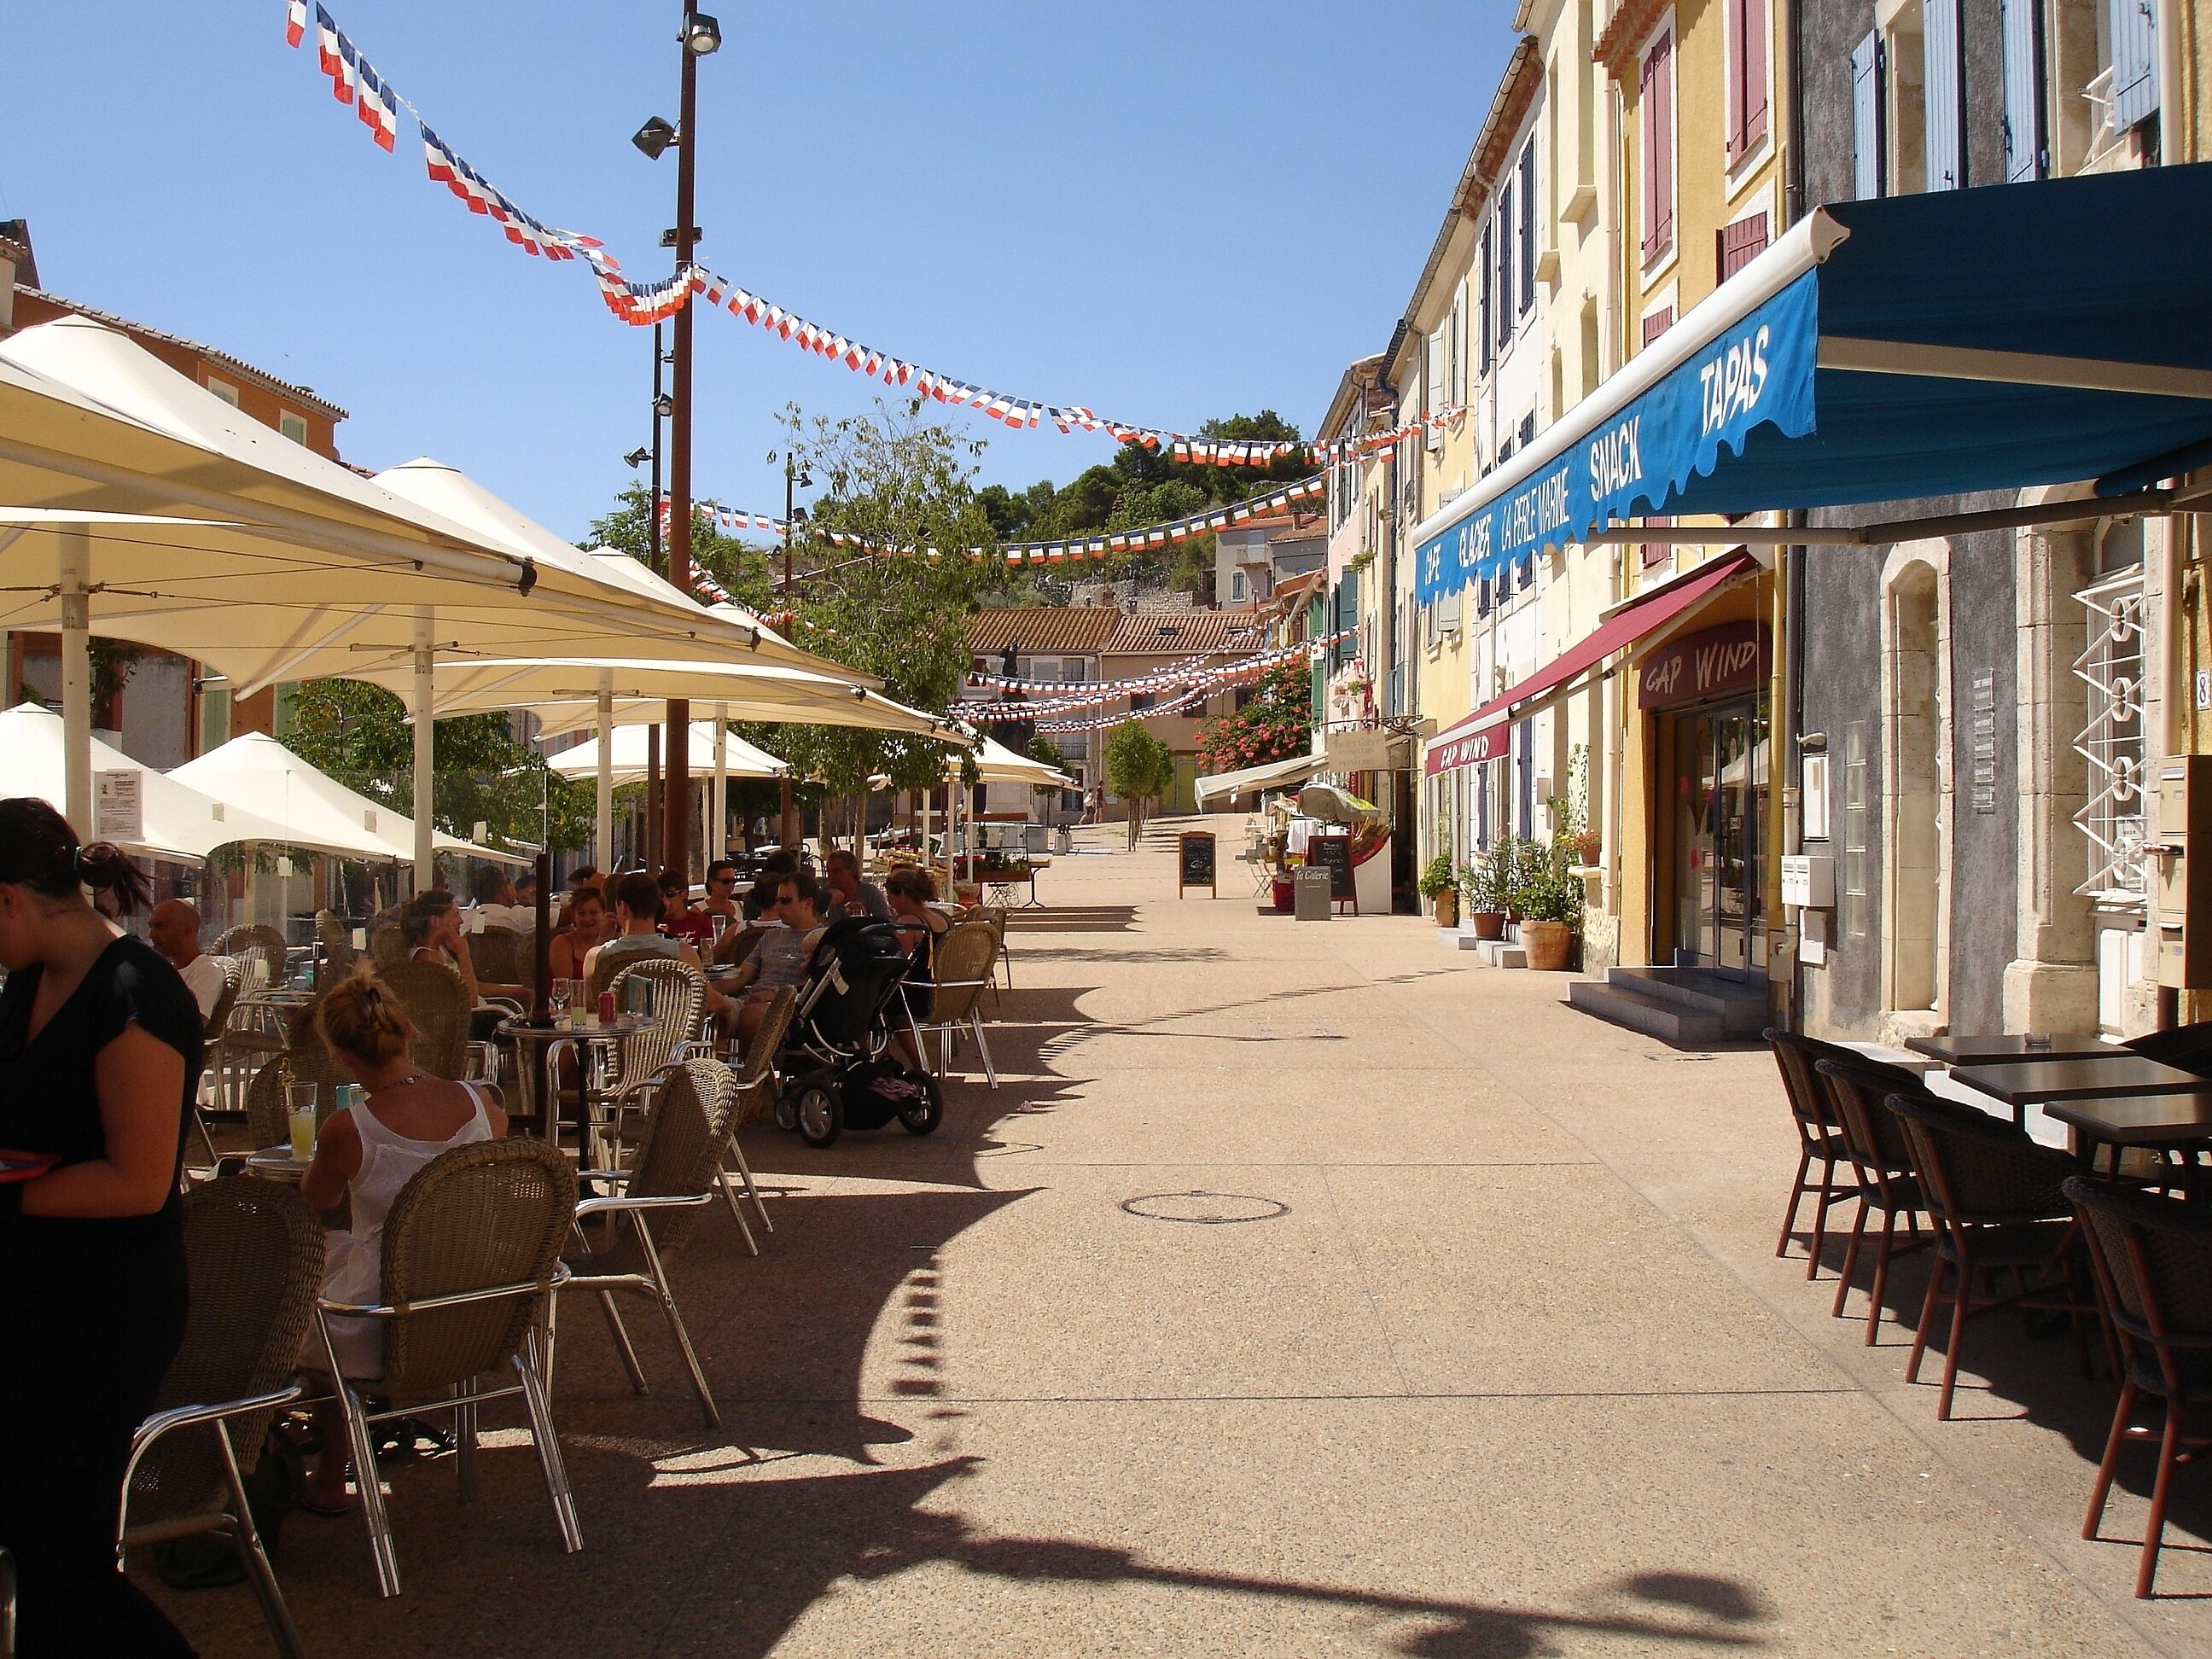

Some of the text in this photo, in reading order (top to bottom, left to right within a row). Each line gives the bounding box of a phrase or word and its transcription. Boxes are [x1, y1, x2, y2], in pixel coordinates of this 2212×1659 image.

[1459, 513, 1492, 568] GLACIER
[1502, 504, 1511, 552] LA
[1514, 487, 1536, 547] PERLE
[1538, 467, 1570, 536] MARINE
[1590, 415, 1642, 502] SNACK
[1700, 324, 1769, 437] TAPAS
[1645, 641, 1756, 694] CAP WIND
[2199, 677, 2206, 703] 8
[1440, 735, 1489, 769] CAP WIND
[1305, 870, 1329, 880] Galerie
